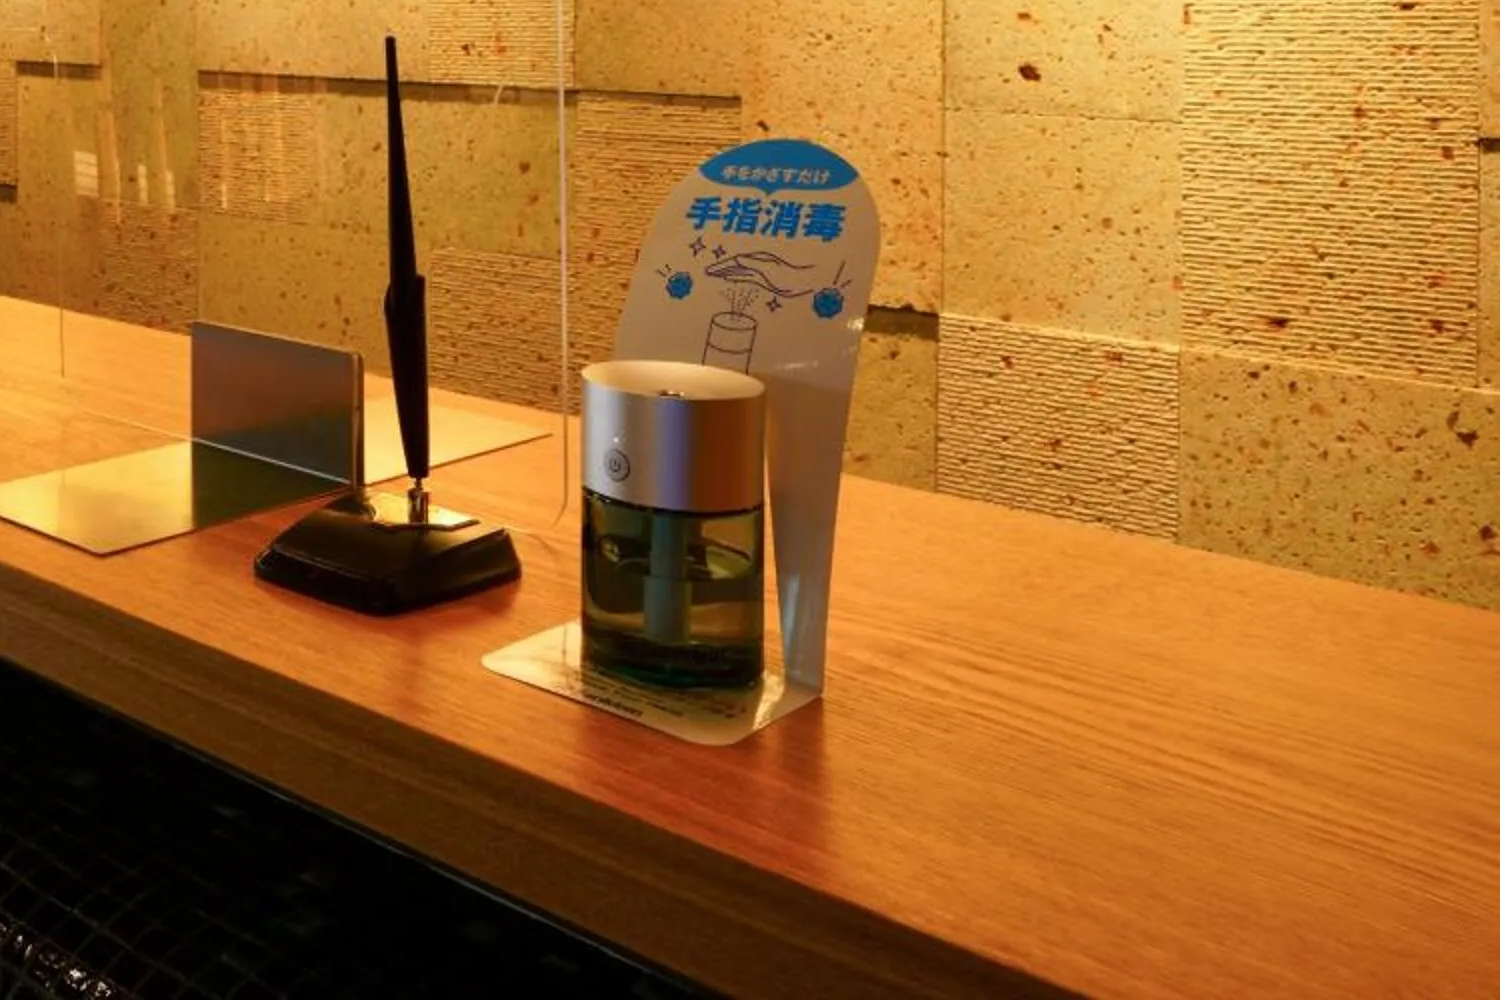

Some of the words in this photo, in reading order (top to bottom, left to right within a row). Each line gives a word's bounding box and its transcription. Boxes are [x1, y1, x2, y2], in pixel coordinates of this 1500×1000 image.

[721, 164, 831, 184] 手をかざすだけ
[686, 196, 847, 242] 手指消毒
